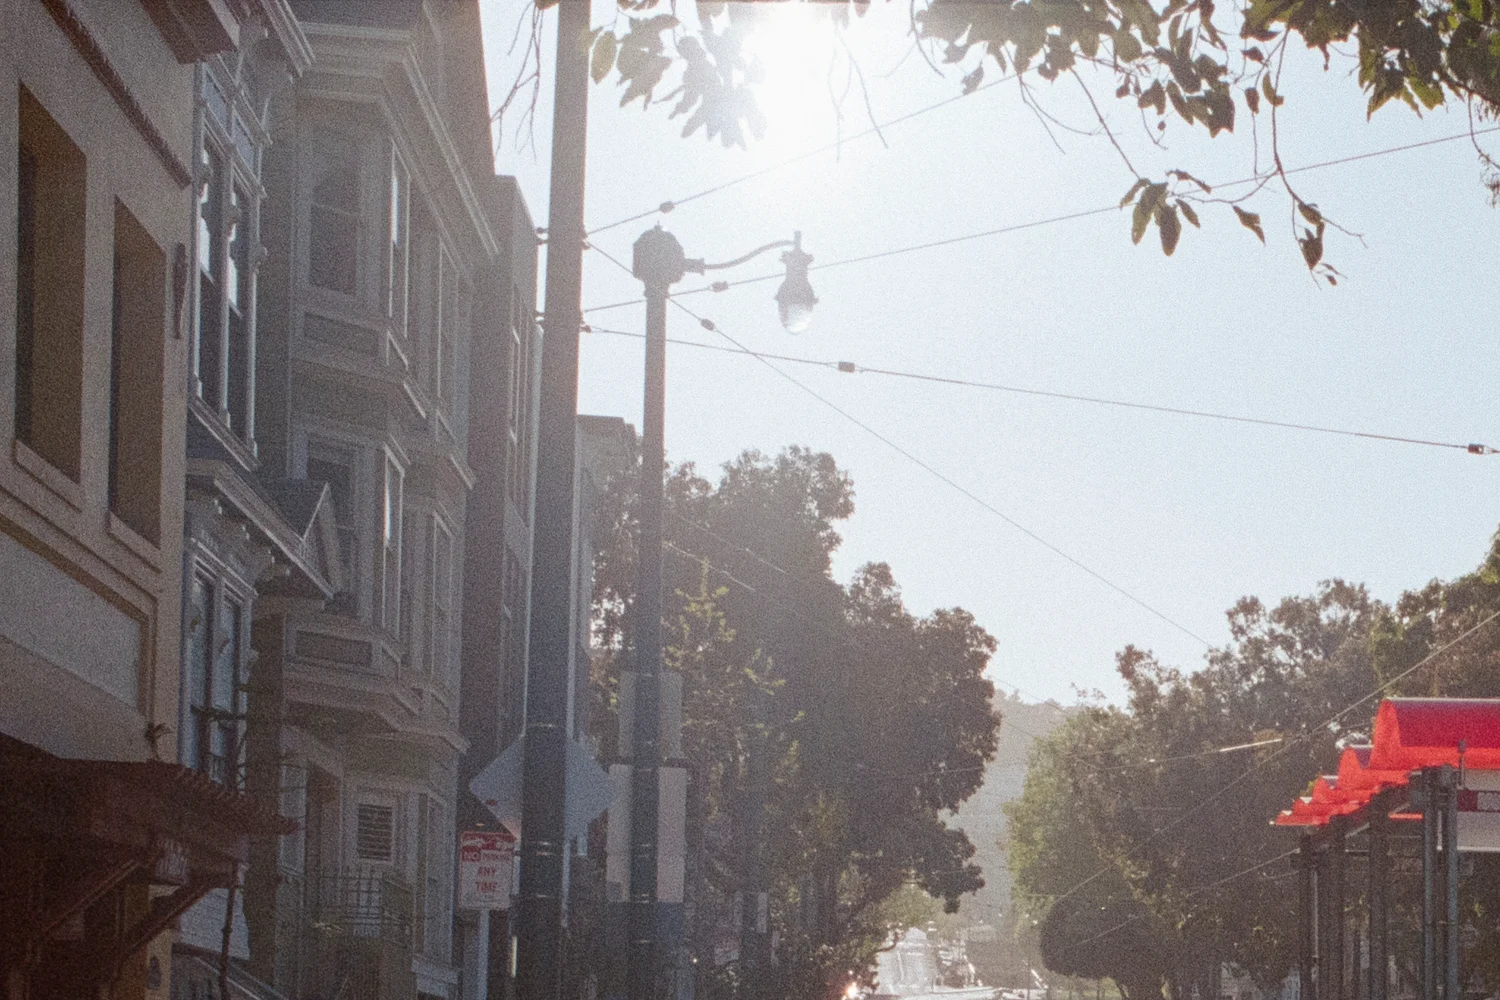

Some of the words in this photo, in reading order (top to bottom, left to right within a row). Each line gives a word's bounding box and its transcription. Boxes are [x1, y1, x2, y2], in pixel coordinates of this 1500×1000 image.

[464, 851, 479, 861] NO
[478, 866, 497, 877] ANY
[475, 881, 498, 893] TIME
